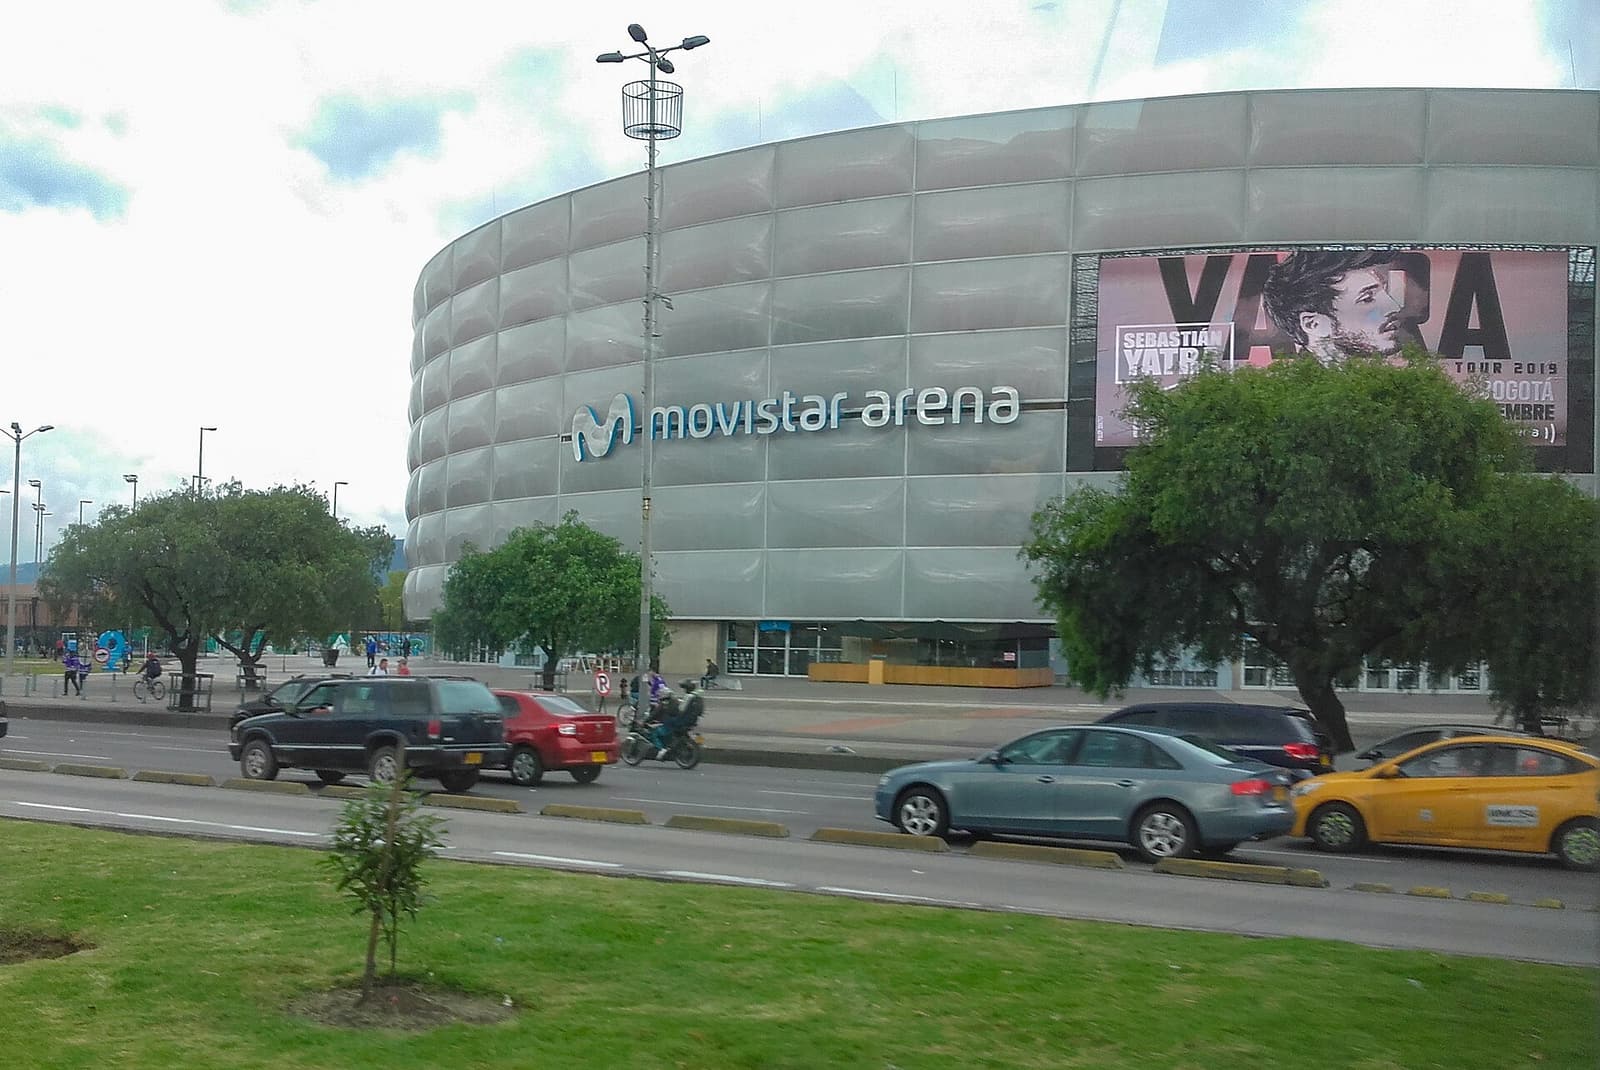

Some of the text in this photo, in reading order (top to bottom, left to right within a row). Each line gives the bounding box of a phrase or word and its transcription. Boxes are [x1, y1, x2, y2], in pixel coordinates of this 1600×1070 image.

[1123, 328, 1222, 348] SEBASTIÁN
[1455, 361, 1558, 375] TOUR 2019
[650, 385, 1020, 440] movistar arena
